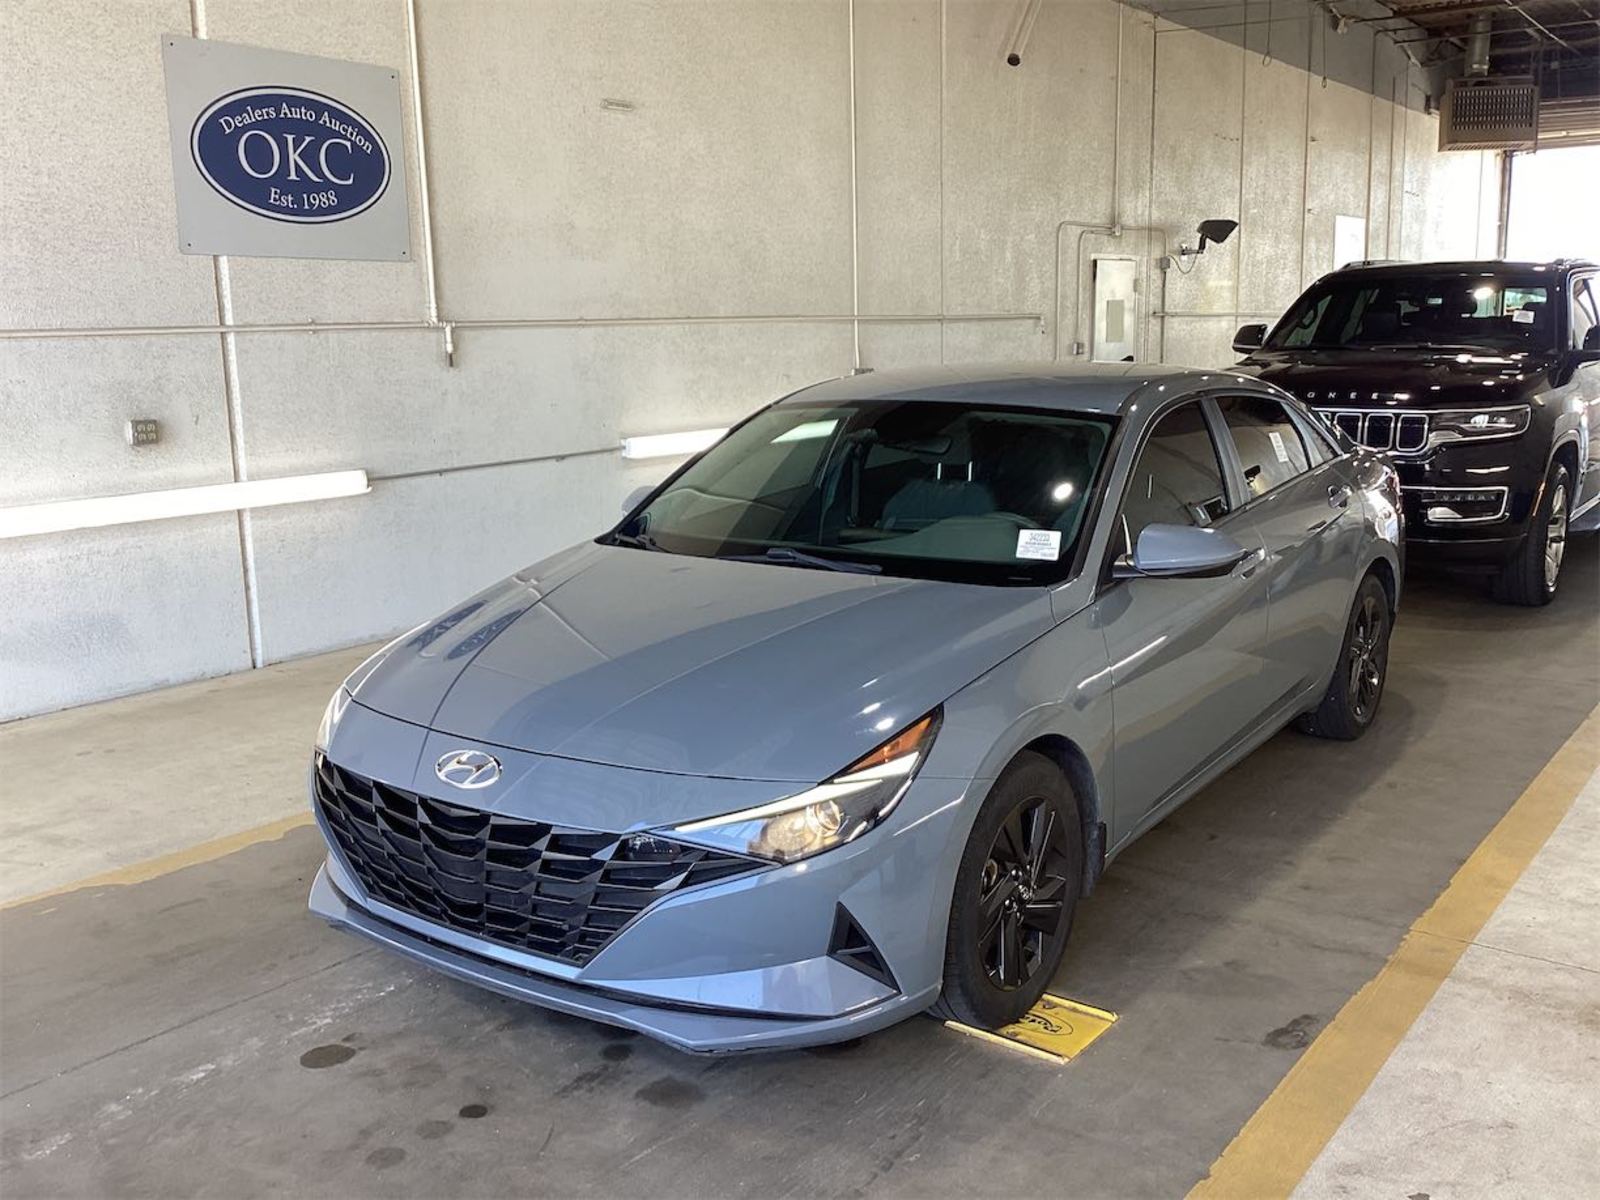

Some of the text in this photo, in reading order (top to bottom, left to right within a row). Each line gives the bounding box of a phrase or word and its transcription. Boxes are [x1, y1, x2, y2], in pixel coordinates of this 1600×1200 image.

[219, 102, 373, 154] Dealers Auto Auction
[238, 130, 354, 185] OKC
[268, 187, 338, 209] Est. 1988
